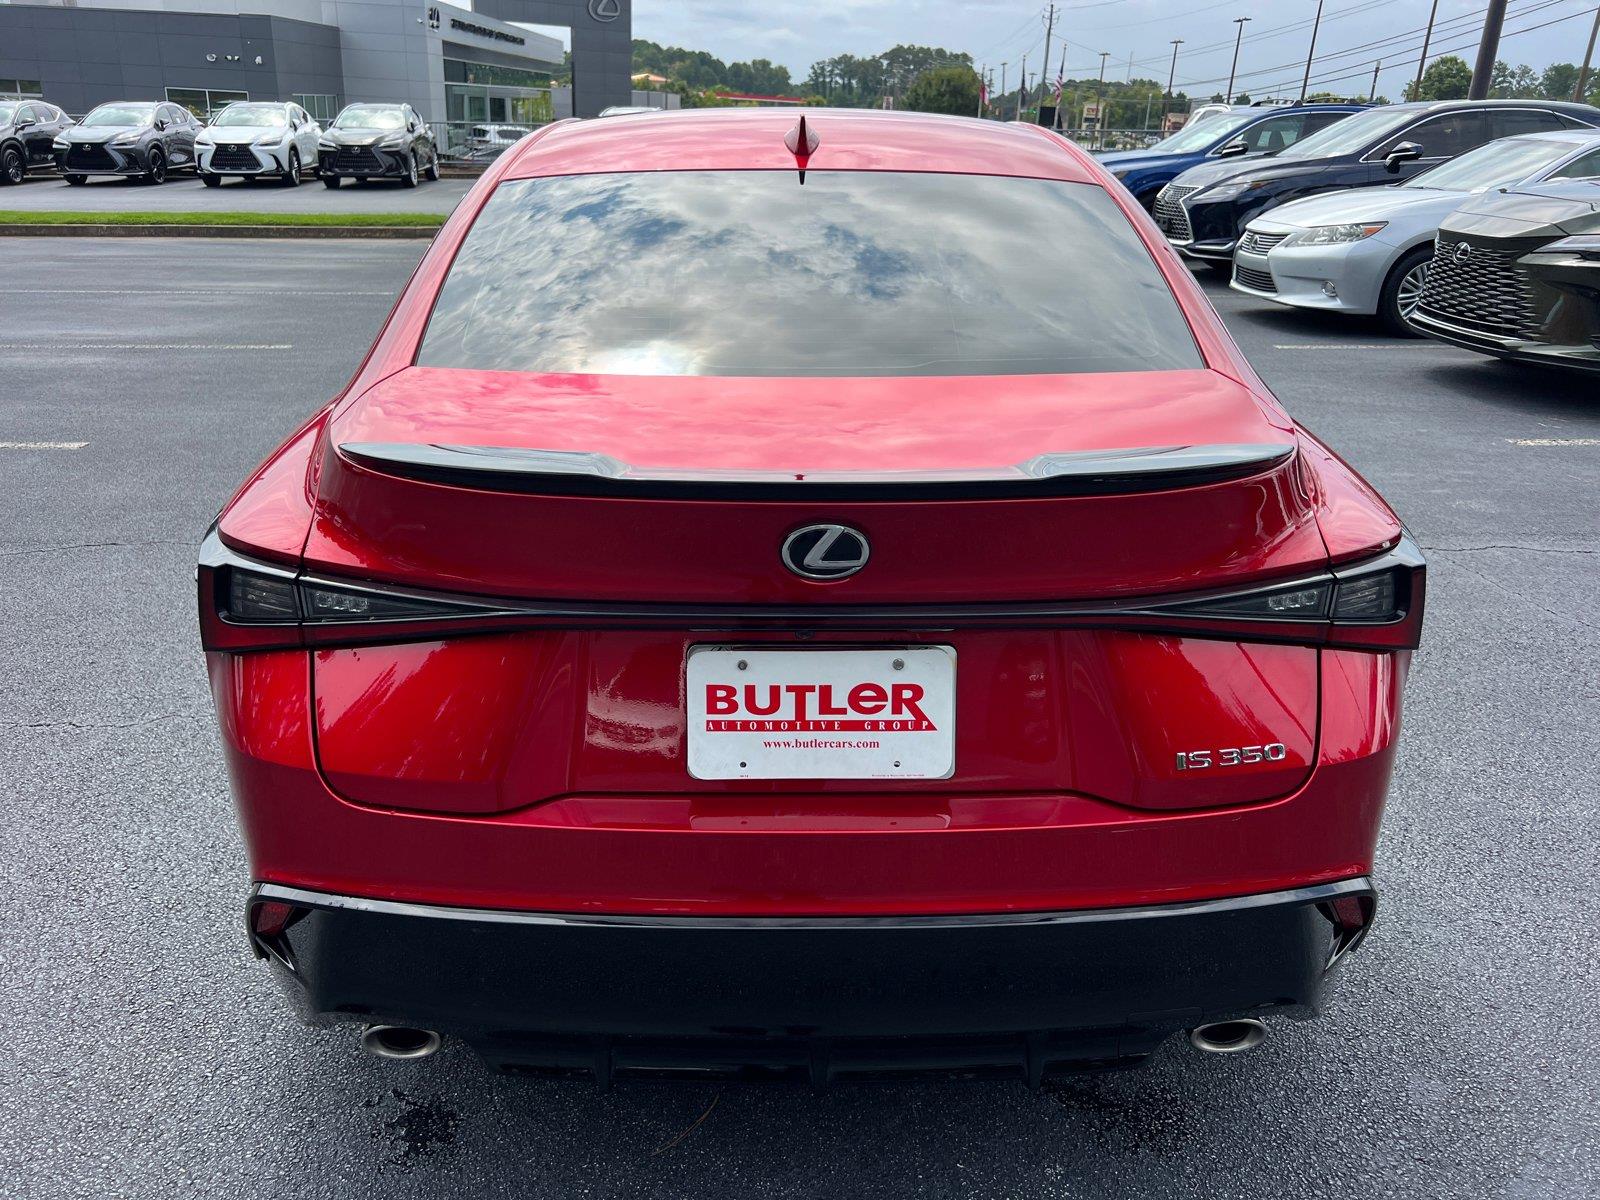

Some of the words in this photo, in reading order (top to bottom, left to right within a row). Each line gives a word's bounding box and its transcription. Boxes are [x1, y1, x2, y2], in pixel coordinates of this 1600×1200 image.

[707, 720, 842, 731] AUTOMOTIVE
[864, 720, 930, 731] GROUP
[763, 738, 880, 749] www.butlercars.com
[1176, 750, 1212, 770] IS
[1218, 743, 1286, 767] 350
